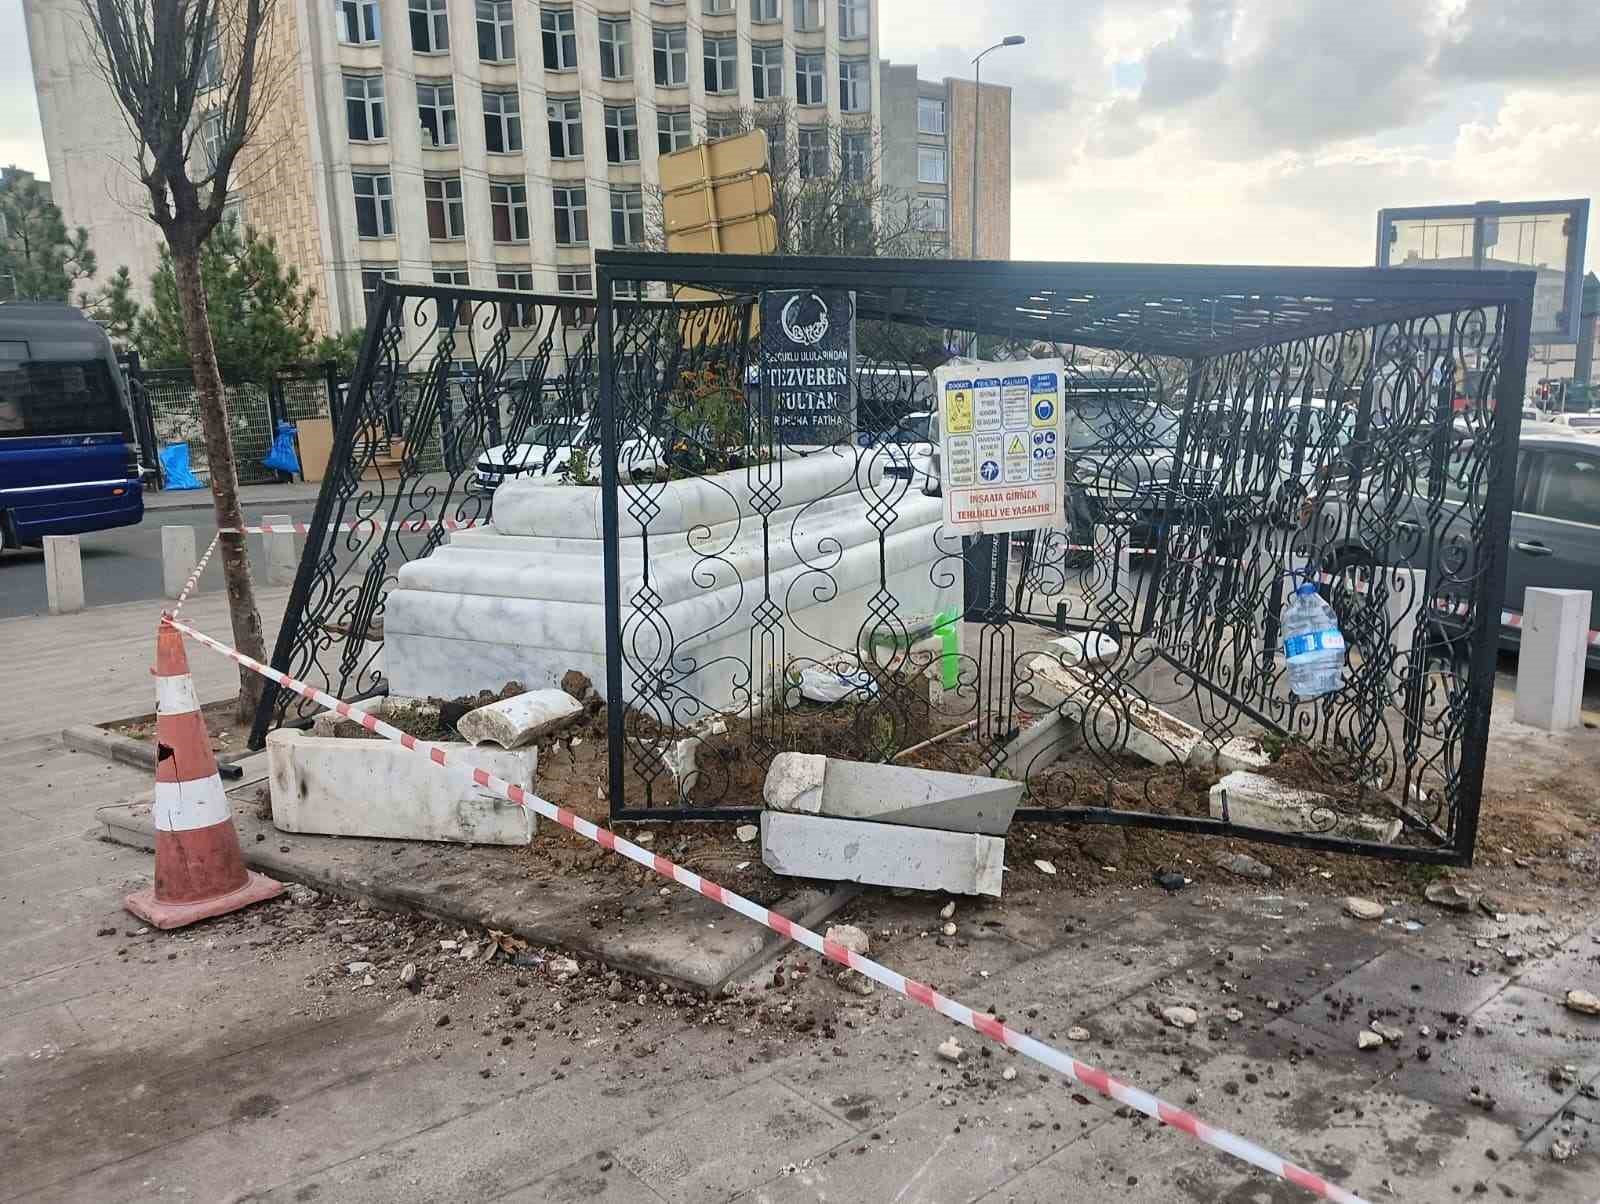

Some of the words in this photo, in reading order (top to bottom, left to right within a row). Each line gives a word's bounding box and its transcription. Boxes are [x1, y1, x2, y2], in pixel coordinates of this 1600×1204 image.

[767, 367, 847, 386] TEZVEREN
[999, 508, 1011, 517] VE
[1011, 504, 1050, 515] YASAKTIR
